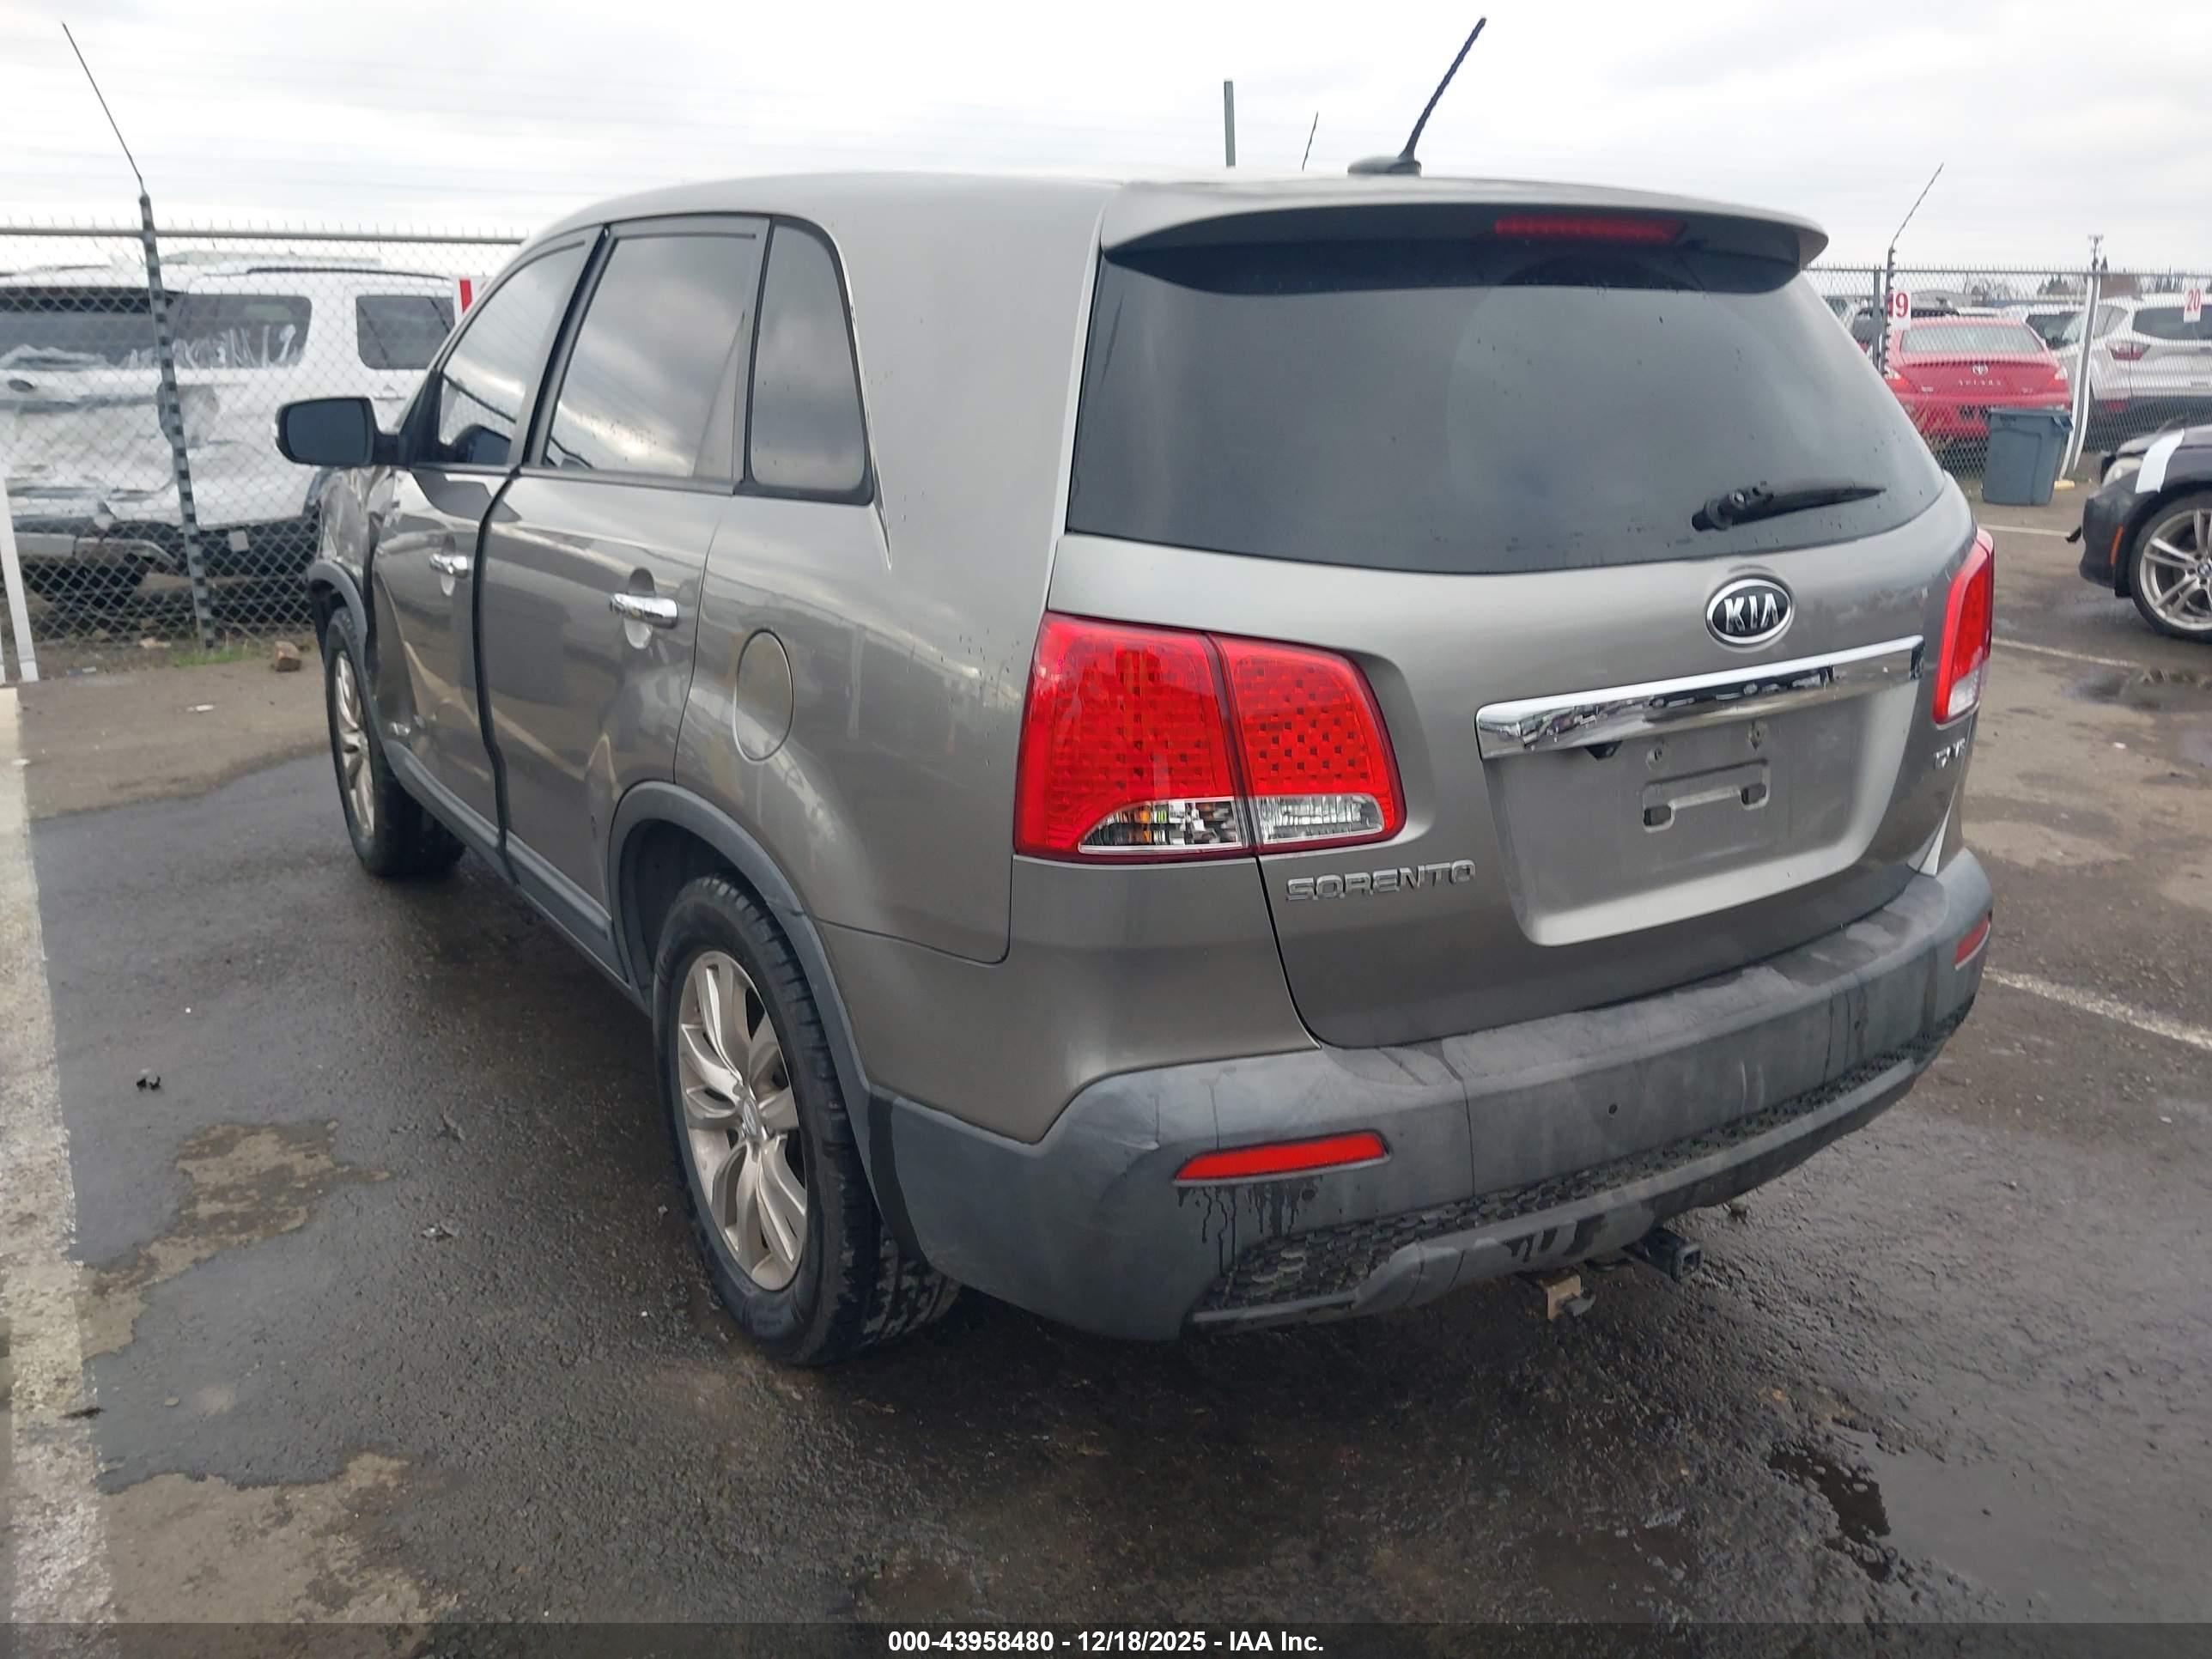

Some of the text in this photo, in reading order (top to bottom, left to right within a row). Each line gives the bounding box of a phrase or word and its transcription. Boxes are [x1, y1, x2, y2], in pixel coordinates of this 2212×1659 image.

[2186, 288, 2201, 313] 20
[1723, 592, 1780, 634] KIA
[1285, 859, 1477, 902] SORENTO
